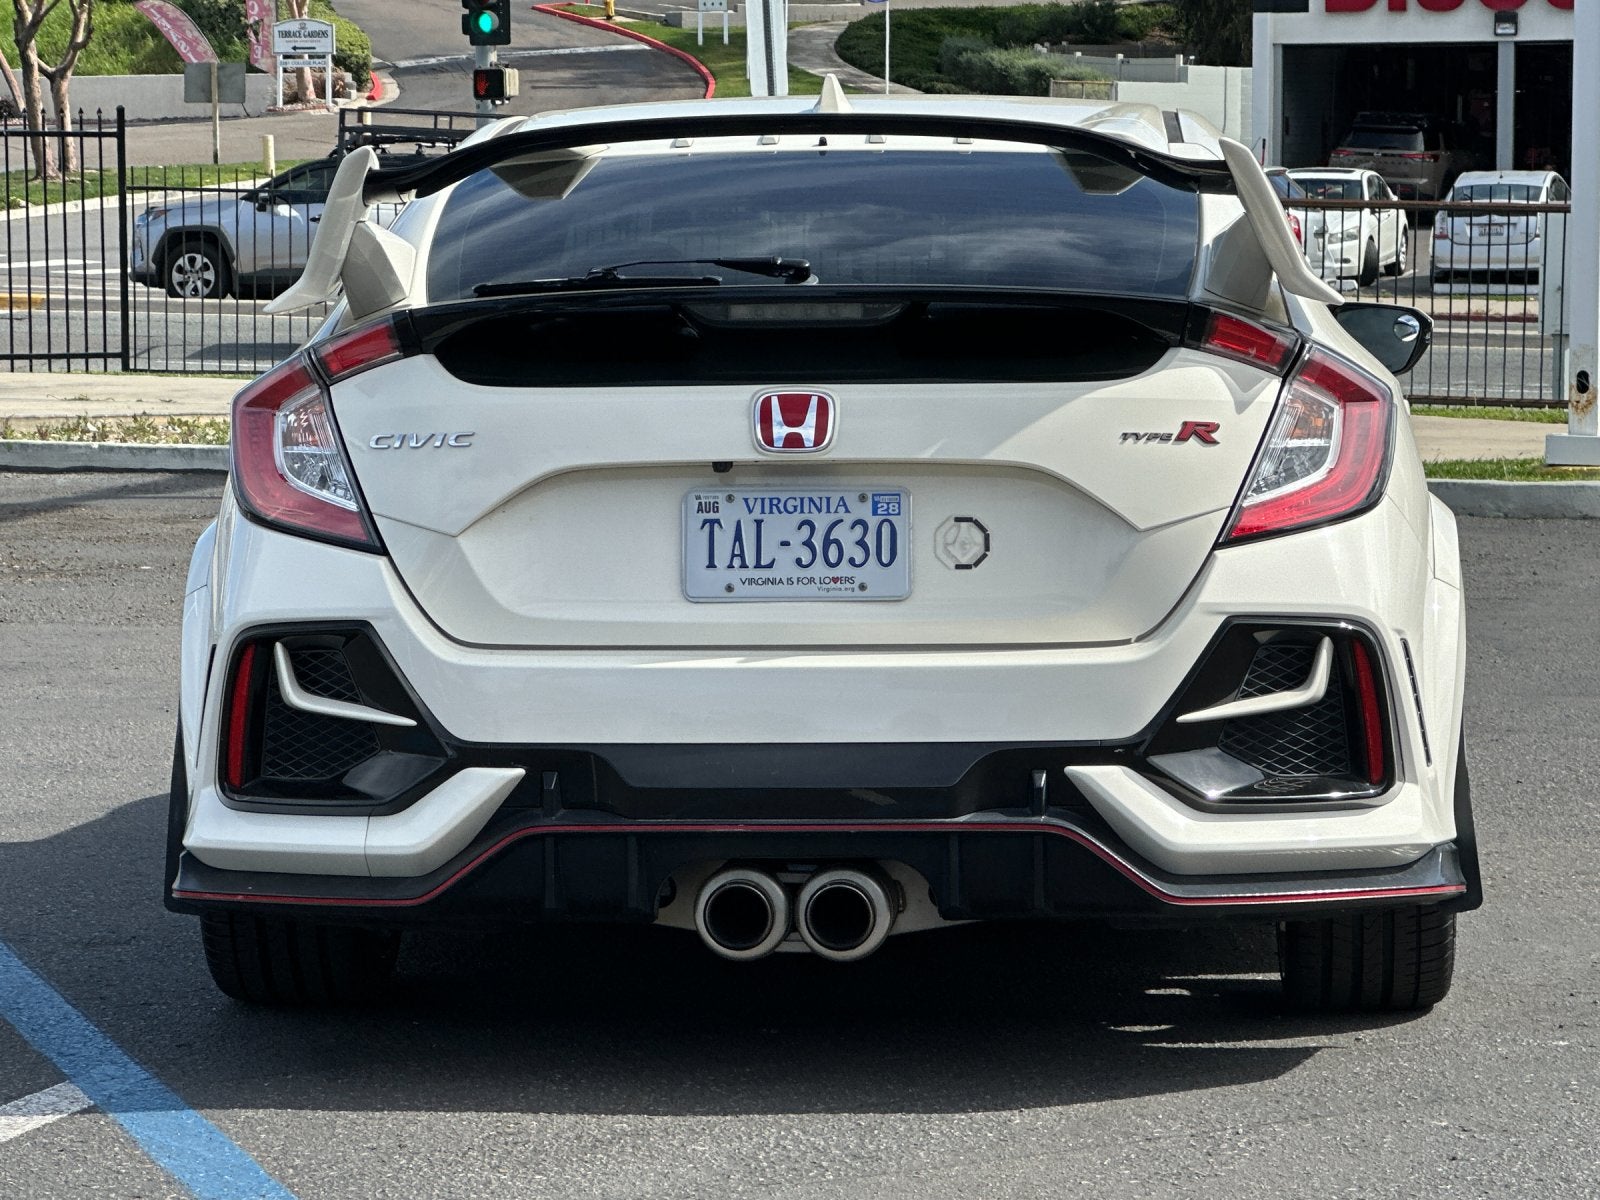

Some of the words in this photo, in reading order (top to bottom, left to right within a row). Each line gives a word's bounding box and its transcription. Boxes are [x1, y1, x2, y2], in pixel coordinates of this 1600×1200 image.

[277, 30, 302, 39] TERRACE
[303, 30, 329, 39] GARDENS
[1120, 432, 1173, 441] TYPE
[1174, 421, 1220, 445] R
[369, 432, 476, 450] CIVIC
[696, 501, 720, 514] AUG
[742, 495, 852, 515] VIRGINIA
[877, 502, 899, 515] 28
[699, 518, 898, 569] TAL-3630
[739, 577, 785, 586] VIRGINIA
[786, 577, 795, 586] IS
[796, 576, 817, 585] FOR
